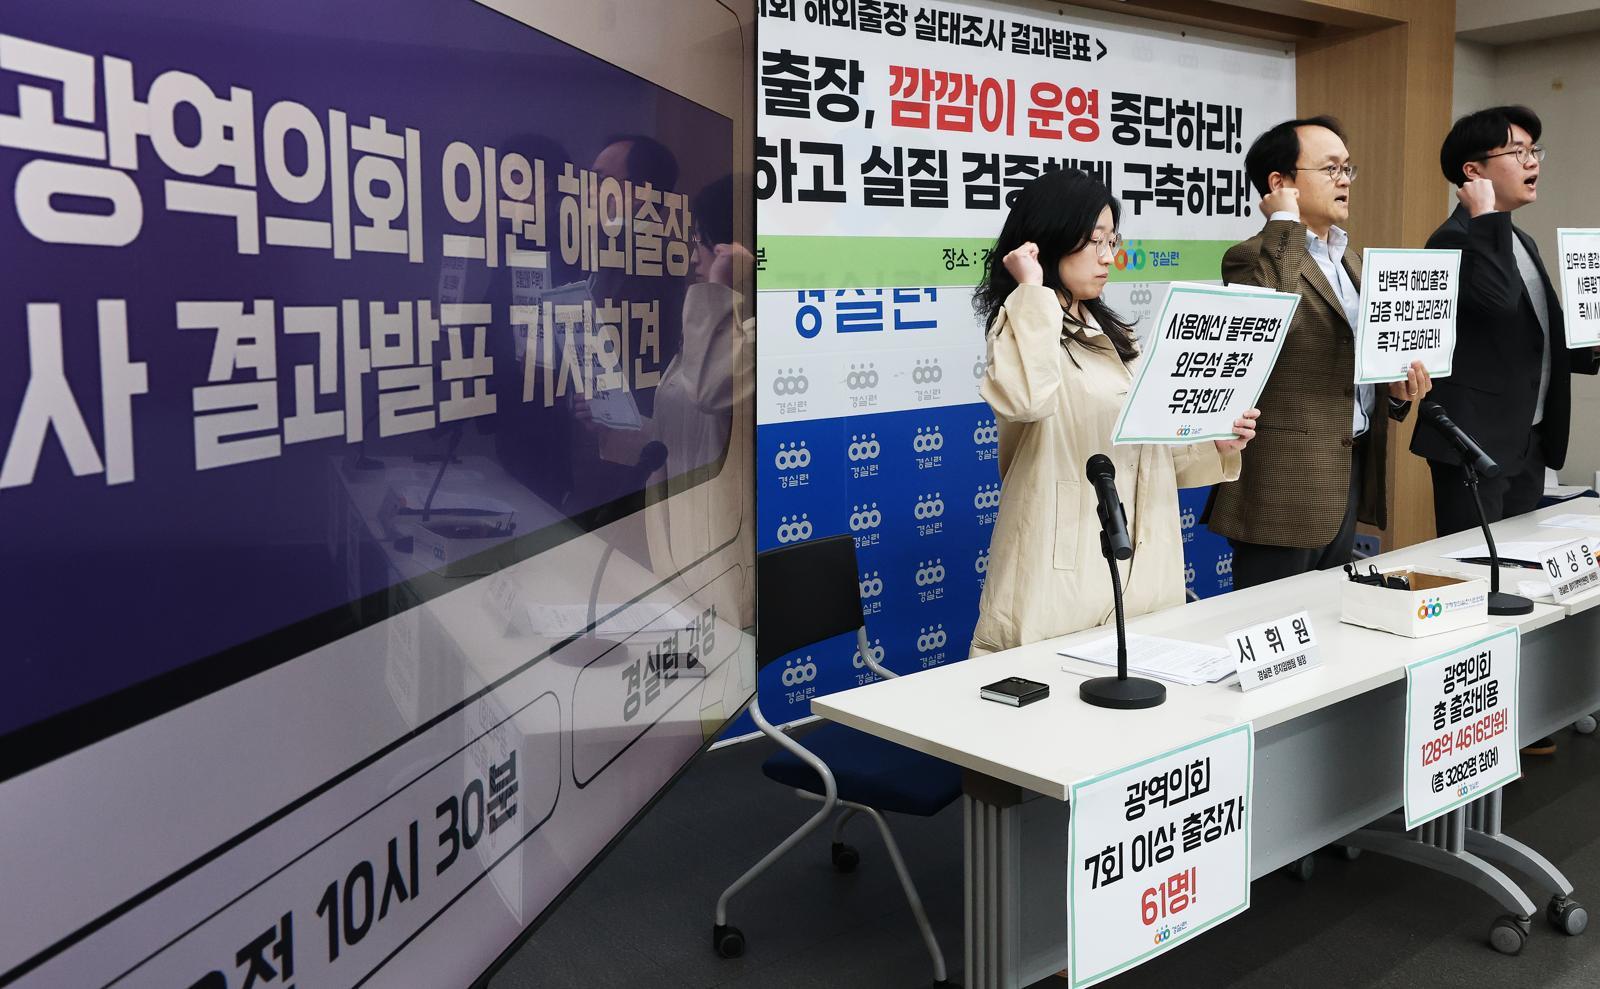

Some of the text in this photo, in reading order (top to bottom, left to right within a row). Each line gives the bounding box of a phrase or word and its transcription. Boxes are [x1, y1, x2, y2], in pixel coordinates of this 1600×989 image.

[804, 0, 908, 36] 해외출장
[914, 7, 1006, 51] 실태조사
[762, 49, 1243, 153] 출장, 깜깜이 운영 중단하라!
[0, 34, 694, 277] 광역의회 의원 해외출장
[757, 137, 1252, 217] 하고 실질 검증 구축하라!
[942, 248, 970, 270] 장소
[1149, 251, 1180, 267] 경실련
[1566, 252, 1587, 270] 외유성
[1378, 269, 1449, 292] 반복적 해외출장
[1369, 299, 1452, 323] 검증 위한 관리장치
[1166, 313, 1282, 342] 사용예산 불투명한
[1377, 329, 1440, 352] 즉각 도입하라!
[1170, 352, 1253, 378] 외유성 출장
[176, 300, 497, 471] 결과발표
[509, 298, 661, 408] 기자회견
[914, 388, 942, 402] 경실련
[776, 400, 807, 415] 경실련
[850, 394, 878, 408] 경실련
[1168, 388, 1235, 414] 우려한다!
[851, 464, 879, 479] 경실련
[915, 456, 942, 469] 경실련
[778, 473, 809, 488] 경실련
[917, 522, 943, 536] 경실련
[918, 589, 944, 602] 경실련
[920, 652, 945, 668] 경실련
[1444, 650, 1491, 694] 광역의회
[622, 631, 678, 722] 경실련
[1257, 667, 1273, 681] 경실련
[785, 687, 815, 704] 경실련
[1433, 680, 1499, 731] 총 출장비용
[1421, 707, 1508, 767] 128억 4616만원!
[1431, 746, 1499, 793] (총 3282명 참여)
[1124, 757, 1211, 822] 광역의회
[1085, 796, 1244, 889] 7회 이상 출장자
[188, 750, 519, 989] 전 10시 30분
[1141, 866, 1197, 926] 61명!
